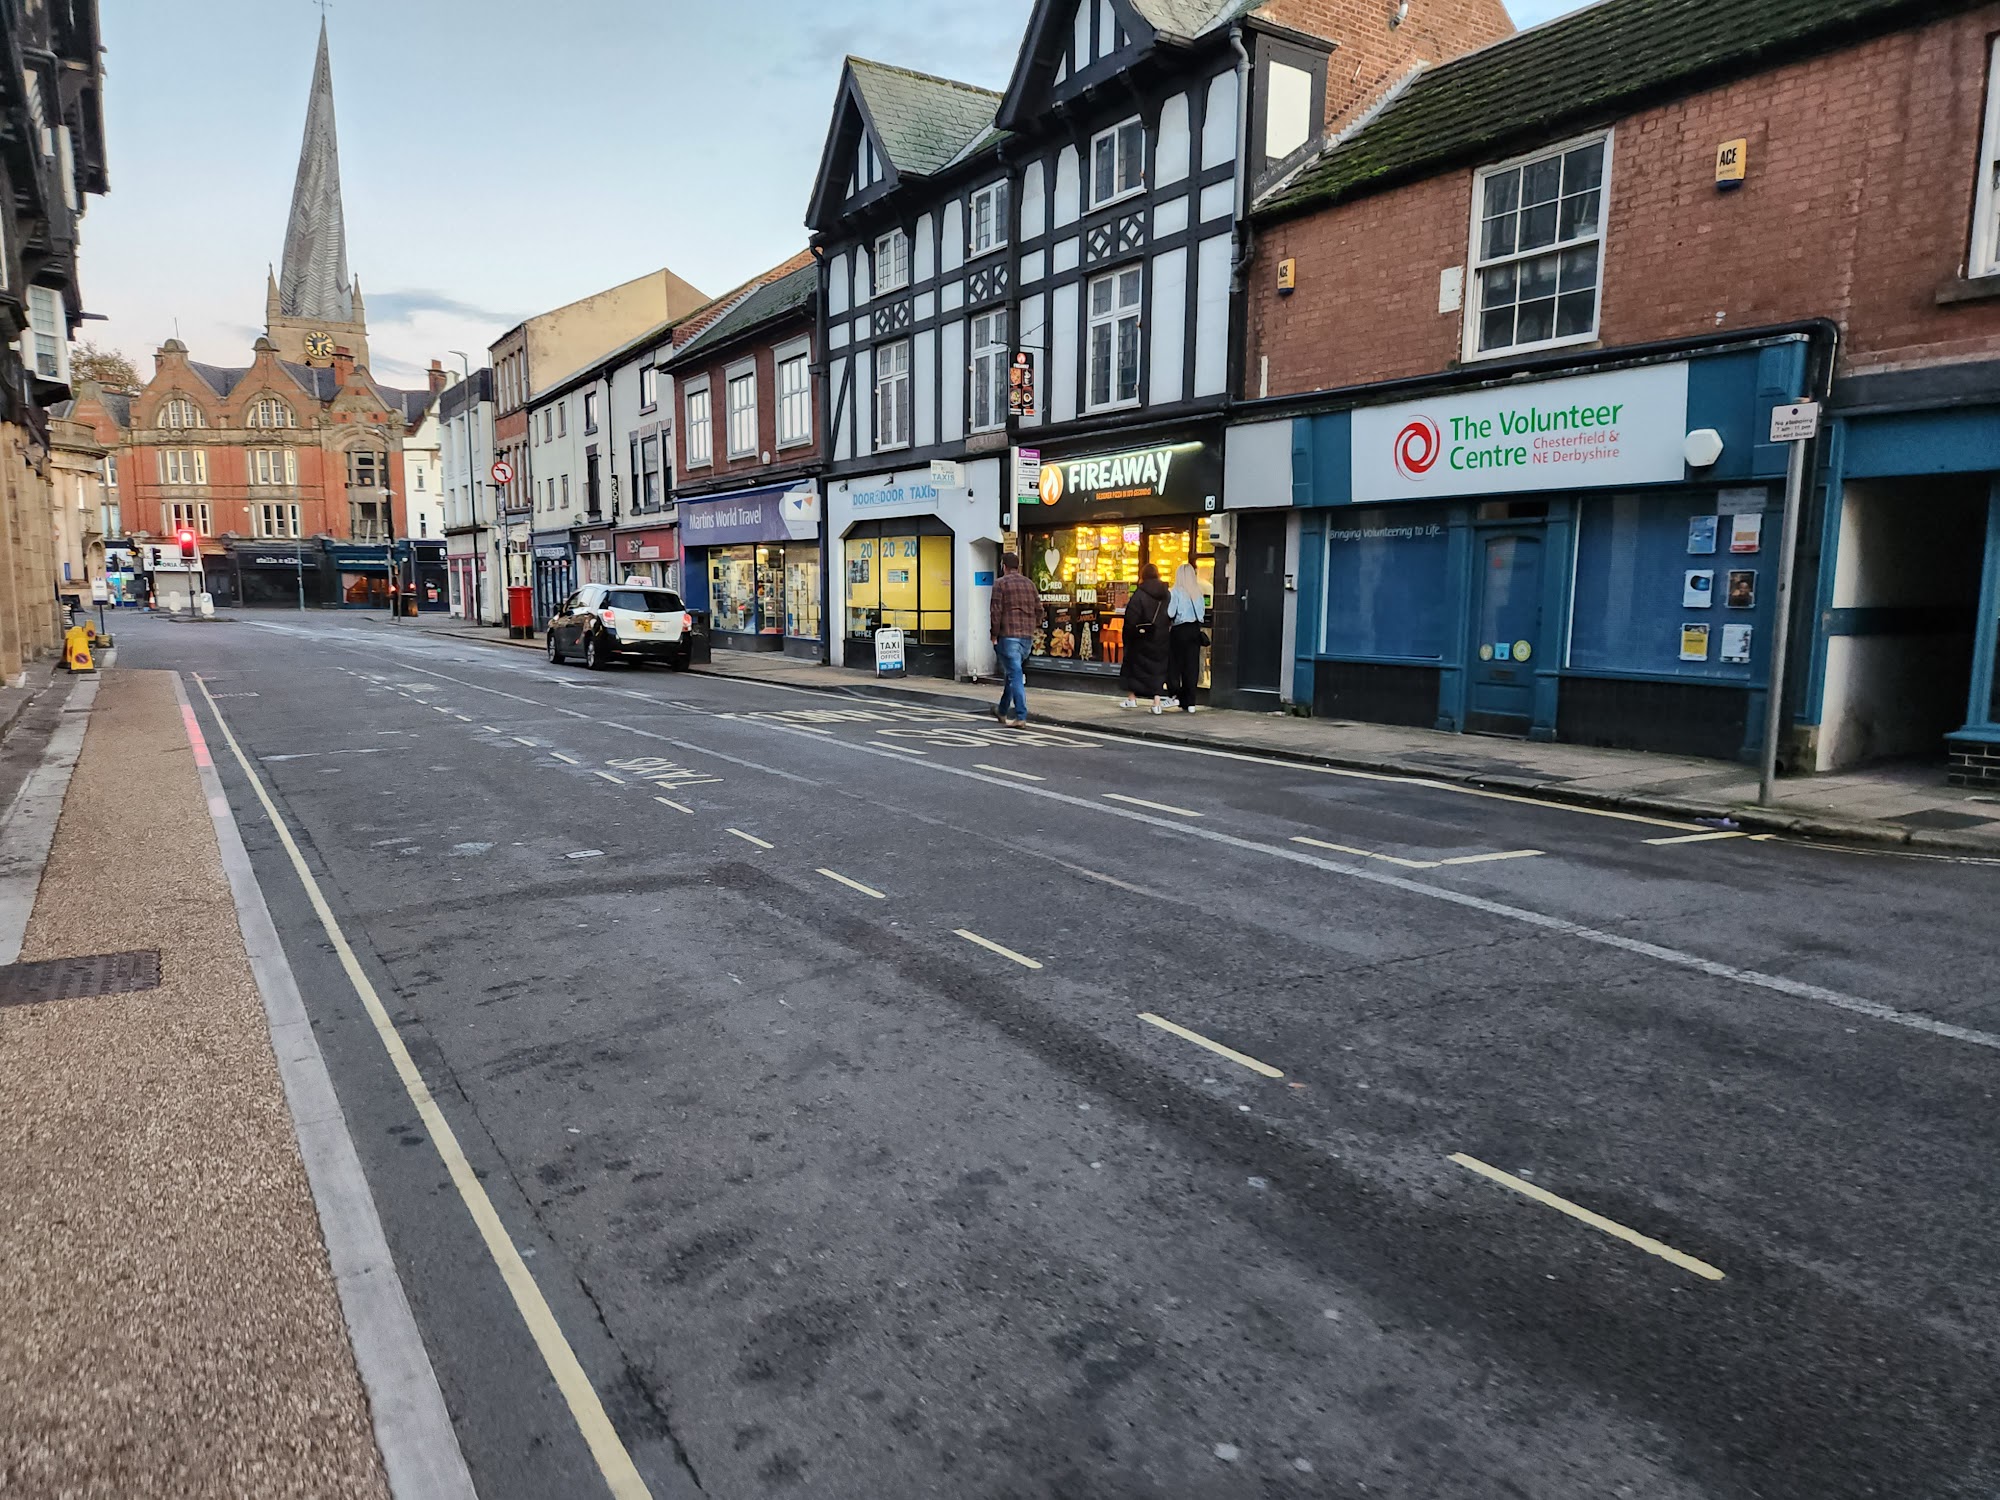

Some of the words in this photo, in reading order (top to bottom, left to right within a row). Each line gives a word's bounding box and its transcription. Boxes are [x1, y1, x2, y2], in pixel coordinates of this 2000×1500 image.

[1719, 147, 1737, 167] ACE
[1449, 415, 1492, 441] The
[1499, 404, 1624, 435] Volunteer
[1533, 431, 1605, 450] Chesterfield
[1608, 430, 1621, 442] &
[1449, 444, 1527, 471] Centre
[1532, 452, 1549, 465] NE
[1552, 446, 1620, 464] Derbyshire
[932, 473, 955, 481] TAXIS
[1068, 450, 1173, 496] FIREAWAY
[910, 484, 937, 499] TAXIS
[689, 511, 715, 530] Martins
[715, 507, 737, 527] World
[738, 503, 762, 525] Travel
[1330, 529, 1361, 541] Bringing
[1363, 526, 1413, 539] Volunteering
[1414, 526, 1424, 536] to
[861, 543, 873, 558] 20
[883, 541, 895, 557] 20
[904, 541, 917, 557] 20
[1038, 593, 1070, 602] LKSHAKES
[1076, 589, 1097, 603] PIZZA
[855, 630, 872, 638] OFFICE
[880, 641, 900, 650] TAXI
